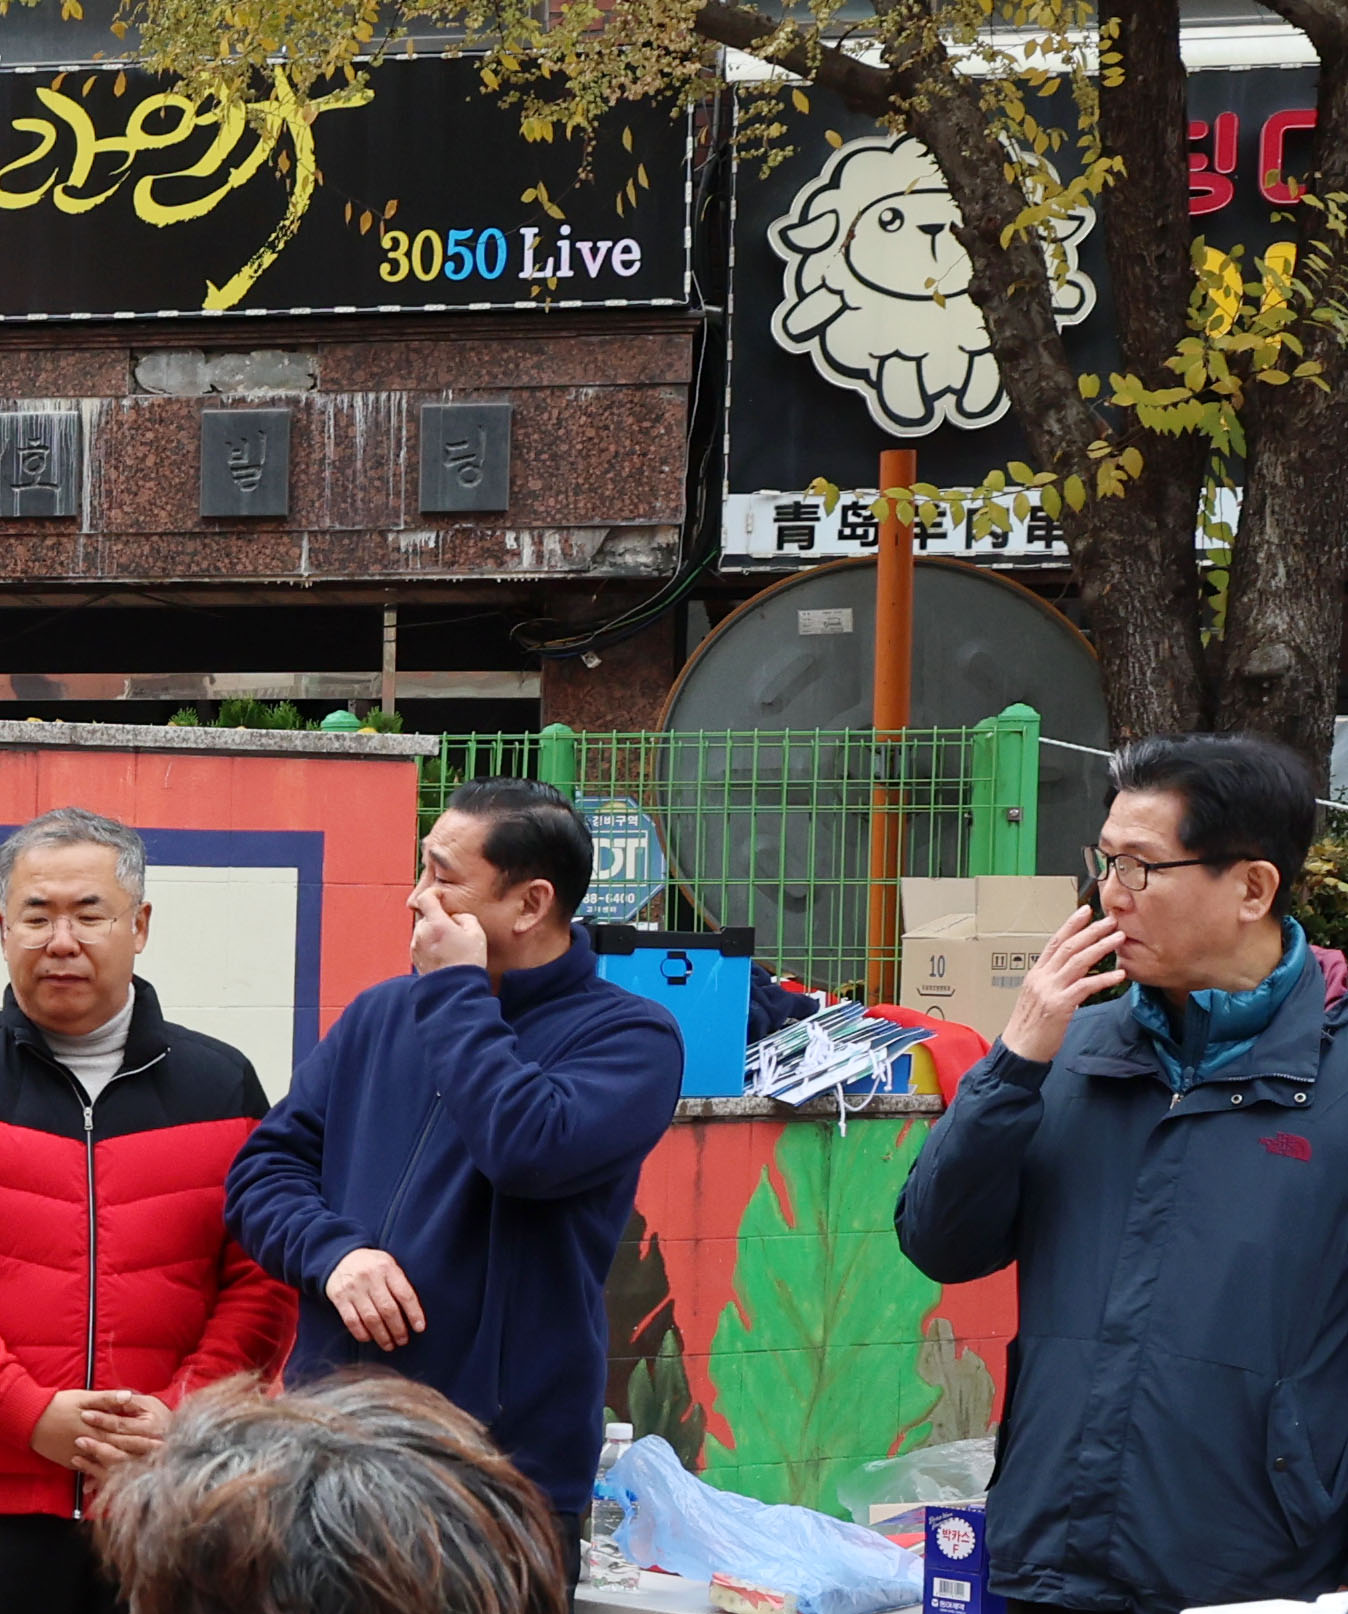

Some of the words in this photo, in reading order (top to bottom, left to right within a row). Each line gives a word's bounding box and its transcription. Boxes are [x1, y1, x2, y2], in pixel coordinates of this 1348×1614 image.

[379, 228, 508, 283] 3050
[518, 225, 643, 279] Live
[928, 954, 946, 978] 10
[941, 1528, 971, 1544] 박카스
[952, 1543, 960, 1555] F
